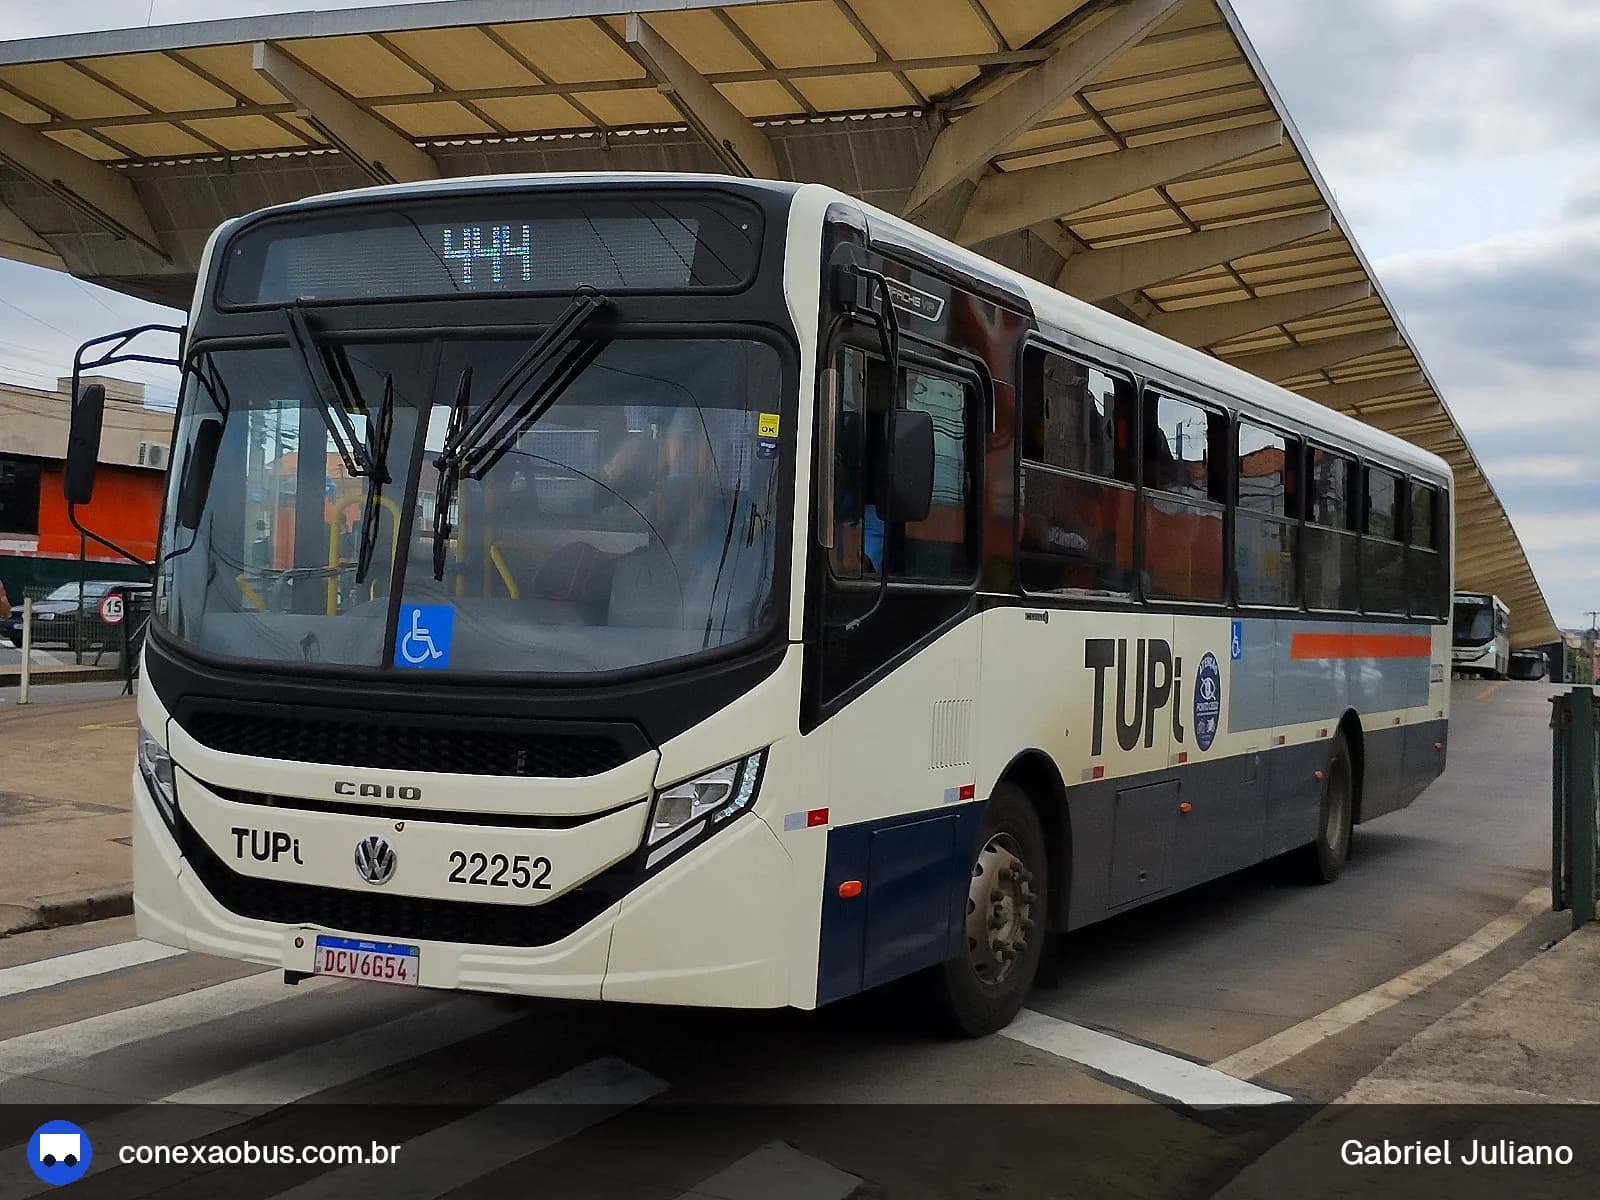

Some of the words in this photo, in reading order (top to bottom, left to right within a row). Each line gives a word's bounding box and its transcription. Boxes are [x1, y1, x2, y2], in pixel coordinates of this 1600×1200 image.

[443, 225, 530, 283] 444
[887, 285, 921, 308] PACHE
[107, 600, 122, 613] 15
[335, 781, 422, 800] CAIO
[448, 850, 552, 890] 22252
[324, 949, 407, 981] DCV6G54
